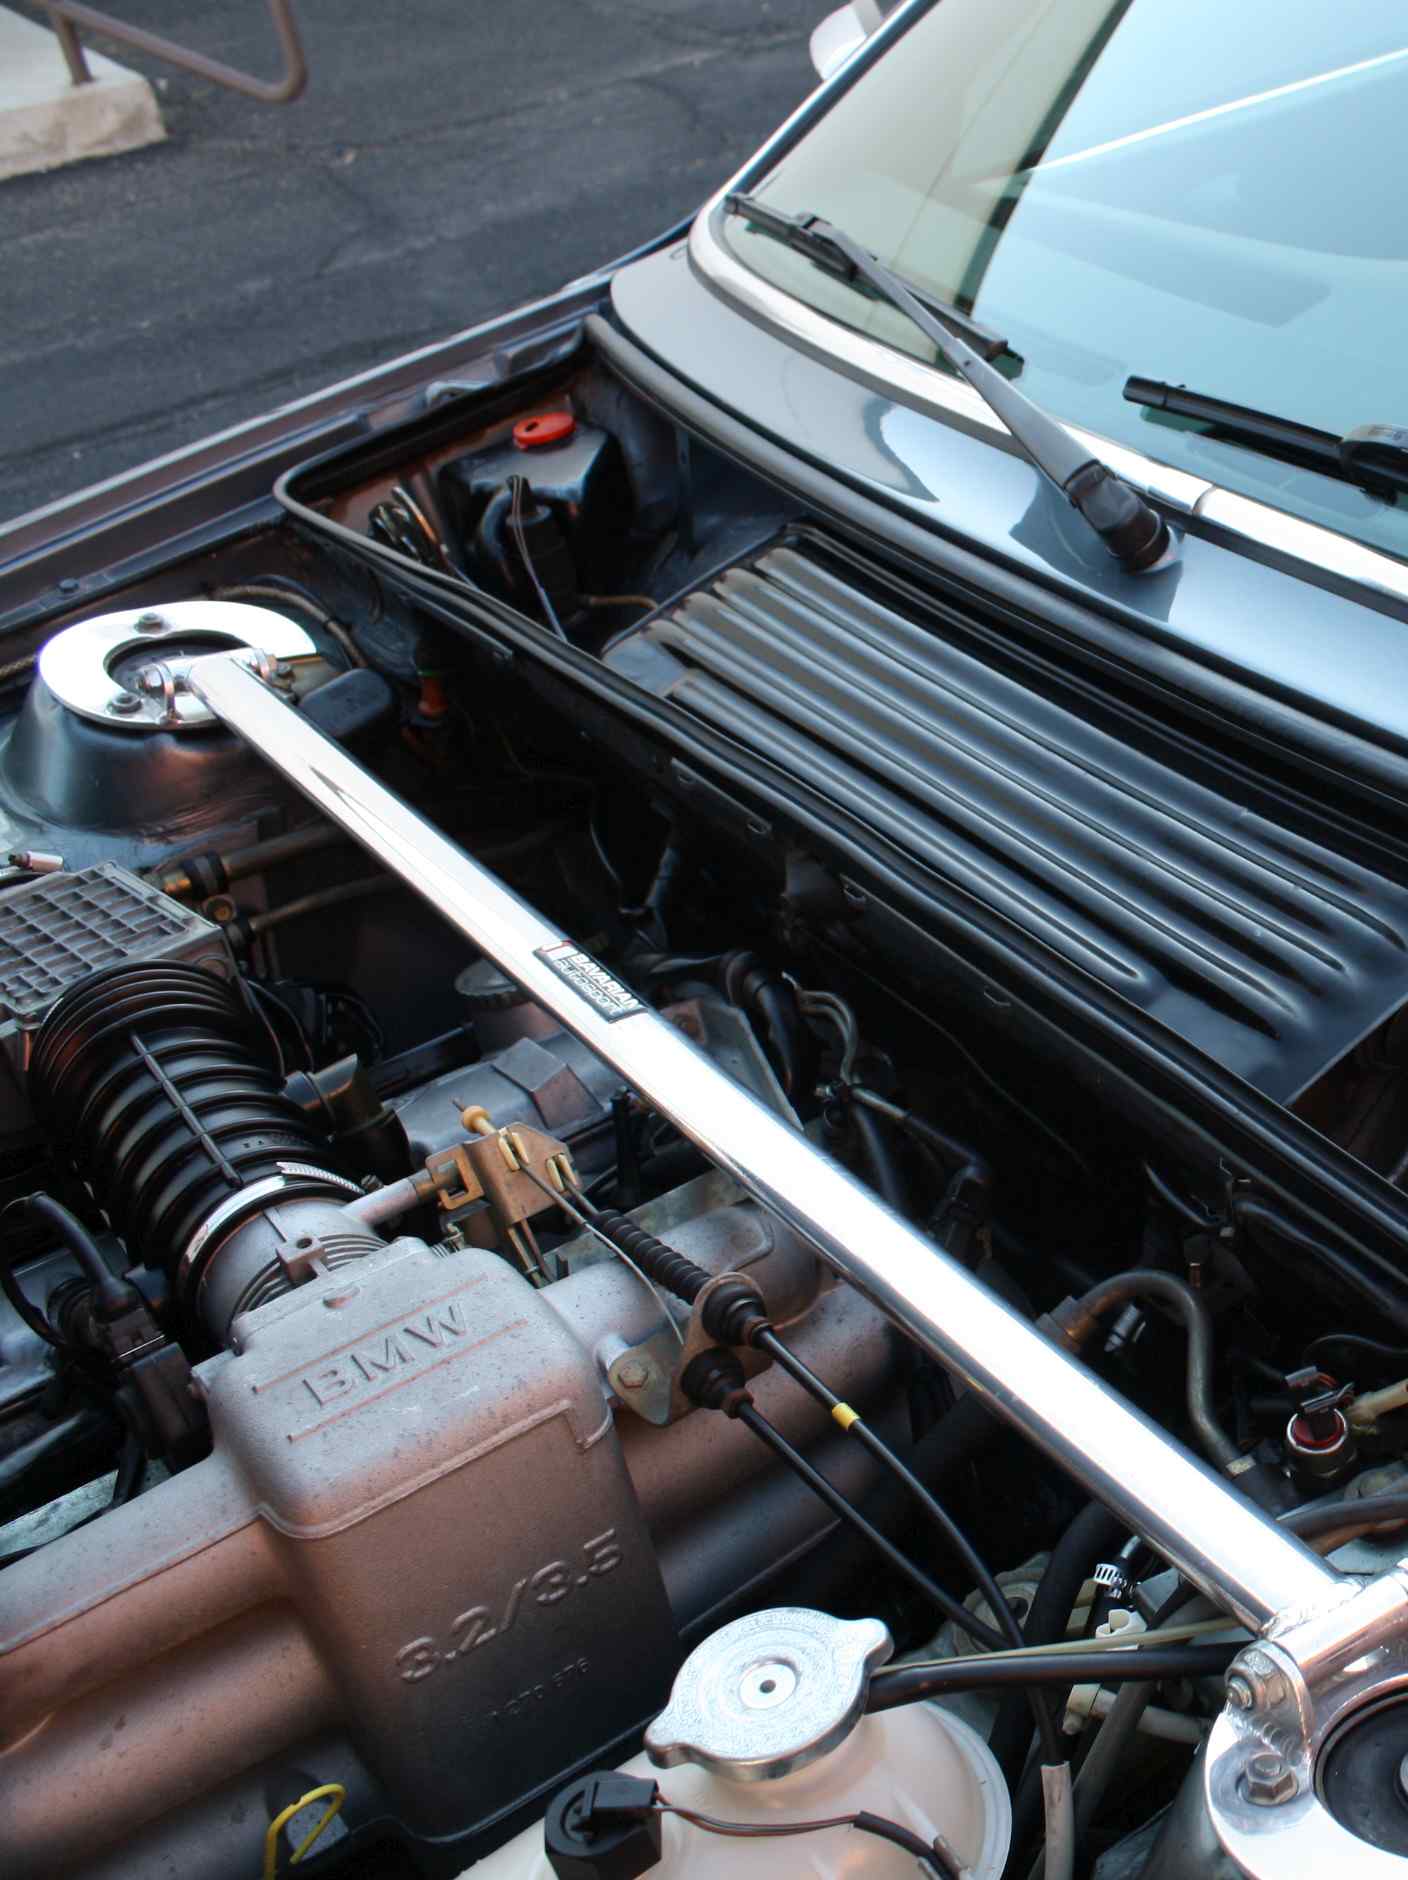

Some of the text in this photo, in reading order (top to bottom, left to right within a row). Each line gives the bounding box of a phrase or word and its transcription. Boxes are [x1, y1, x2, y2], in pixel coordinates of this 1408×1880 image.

[569, 952, 641, 1009] BAVARIAN
[302, 1303, 469, 1405] BMW
[395, 1528, 623, 1682] 3.2/3.5
